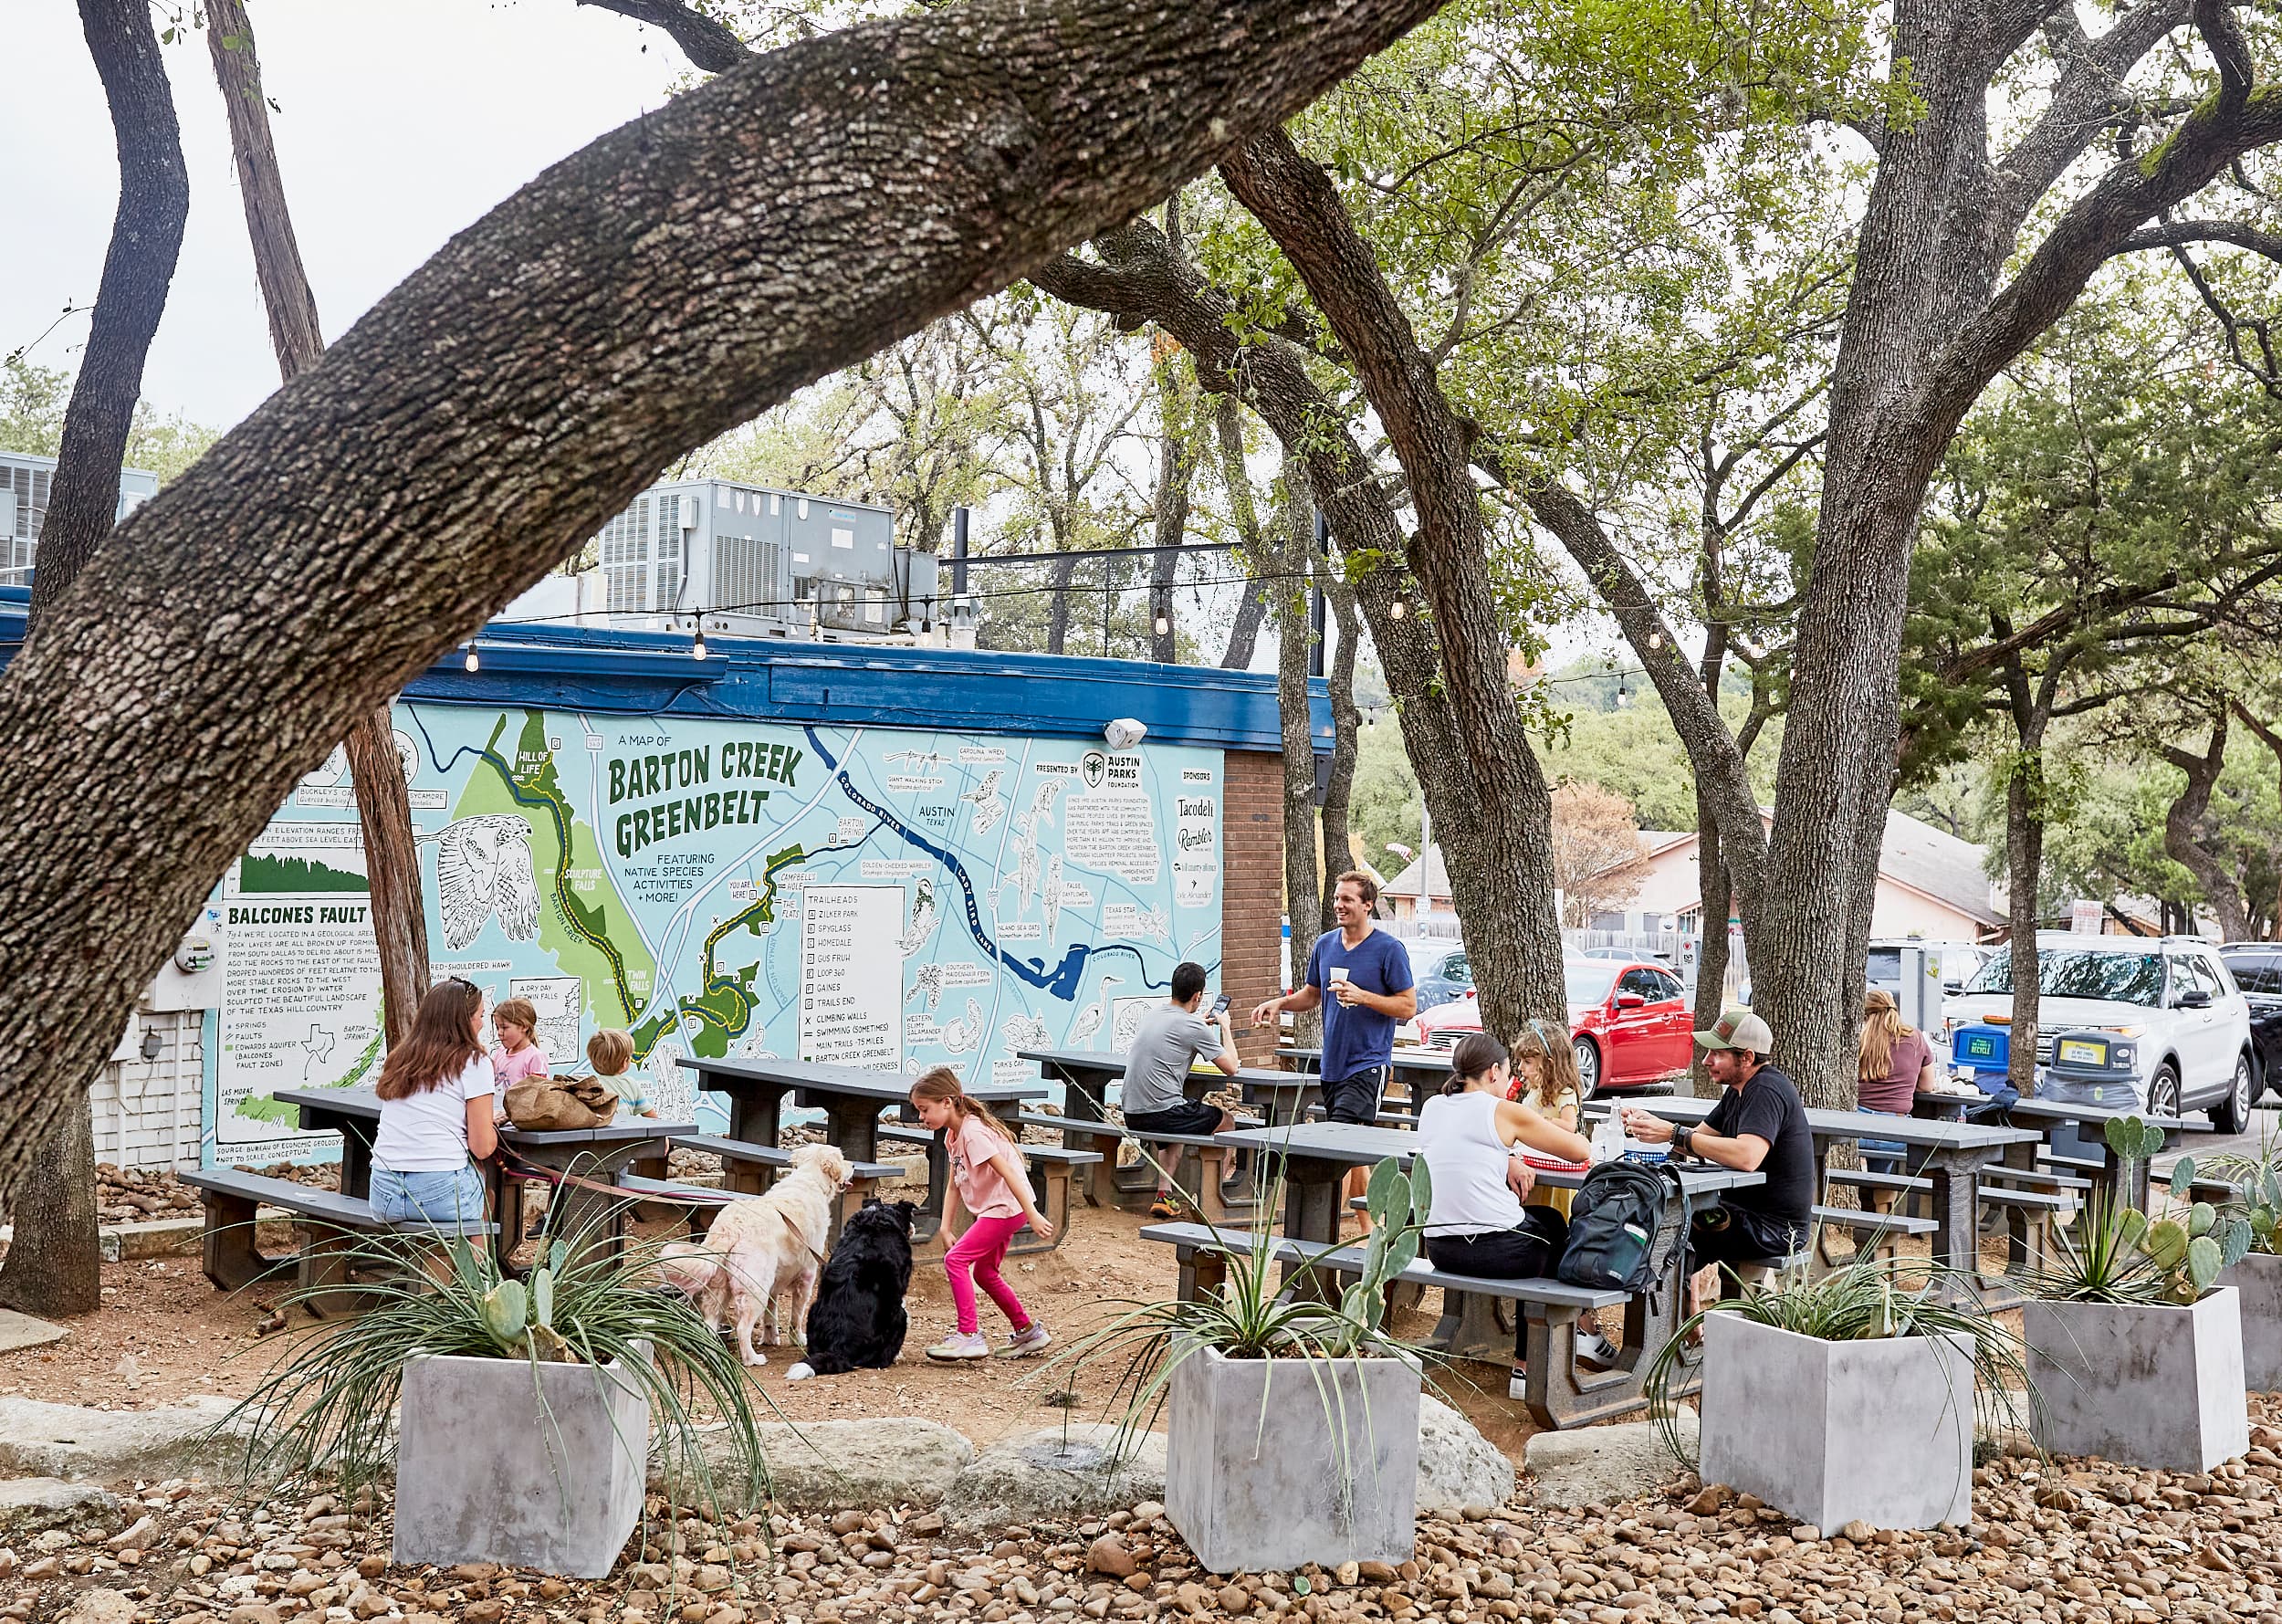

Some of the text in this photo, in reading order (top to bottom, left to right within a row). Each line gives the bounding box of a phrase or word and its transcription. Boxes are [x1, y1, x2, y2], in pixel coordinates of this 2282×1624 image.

[619, 736, 671, 746] A MAP OF
[519, 751, 548, 761] HILL OF
[1108, 757, 1139, 767] AUSTIN
[521, 764, 540, 774] LIFE
[609, 742, 802, 805] BARTON CREEK
[1108, 769, 1136, 779] PARKS
[1184, 772, 1210, 781] SPONSORS
[841, 777, 900, 831] COLORADO RIVER
[1178, 799, 1213, 817] Tacodeli
[919, 806, 955, 817] AUSTIN
[616, 791, 769, 859] GREENBELT
[839, 819, 864, 827] BARTON
[658, 854, 715, 864] FEATURING
[565, 869, 602, 879] SCULPTURE
[625, 867, 703, 876] NATIVE SPECIES
[575, 881, 595, 890] FALLS
[633, 880, 692, 889] ACTIVITIES
[646, 893, 677, 902] MORE!
[229, 906, 366, 924] BALCONES FAULT
[958, 869, 992, 952] LADY BIRD LAKE
[550, 893, 583, 944] BARTON CREEK
[1093, 952, 1119, 961] COLORADO
[431, 962, 488, 970] RED-SHOULDERED
[627, 970, 646, 979] TWIN
[631, 981, 649, 990] FALLS
[817, 983, 840, 991] GAINES
[817, 997, 854, 1007] TRAILS END
[817, 1014, 844, 1023] CLIMBING
[817, 1023, 888, 1036] SWIMMING (SOMETIMES)
[816, 1049, 894, 1063] BARTON CREEK GREENBELT
[268, 1149, 310, 1159] CONCEPTUAL
